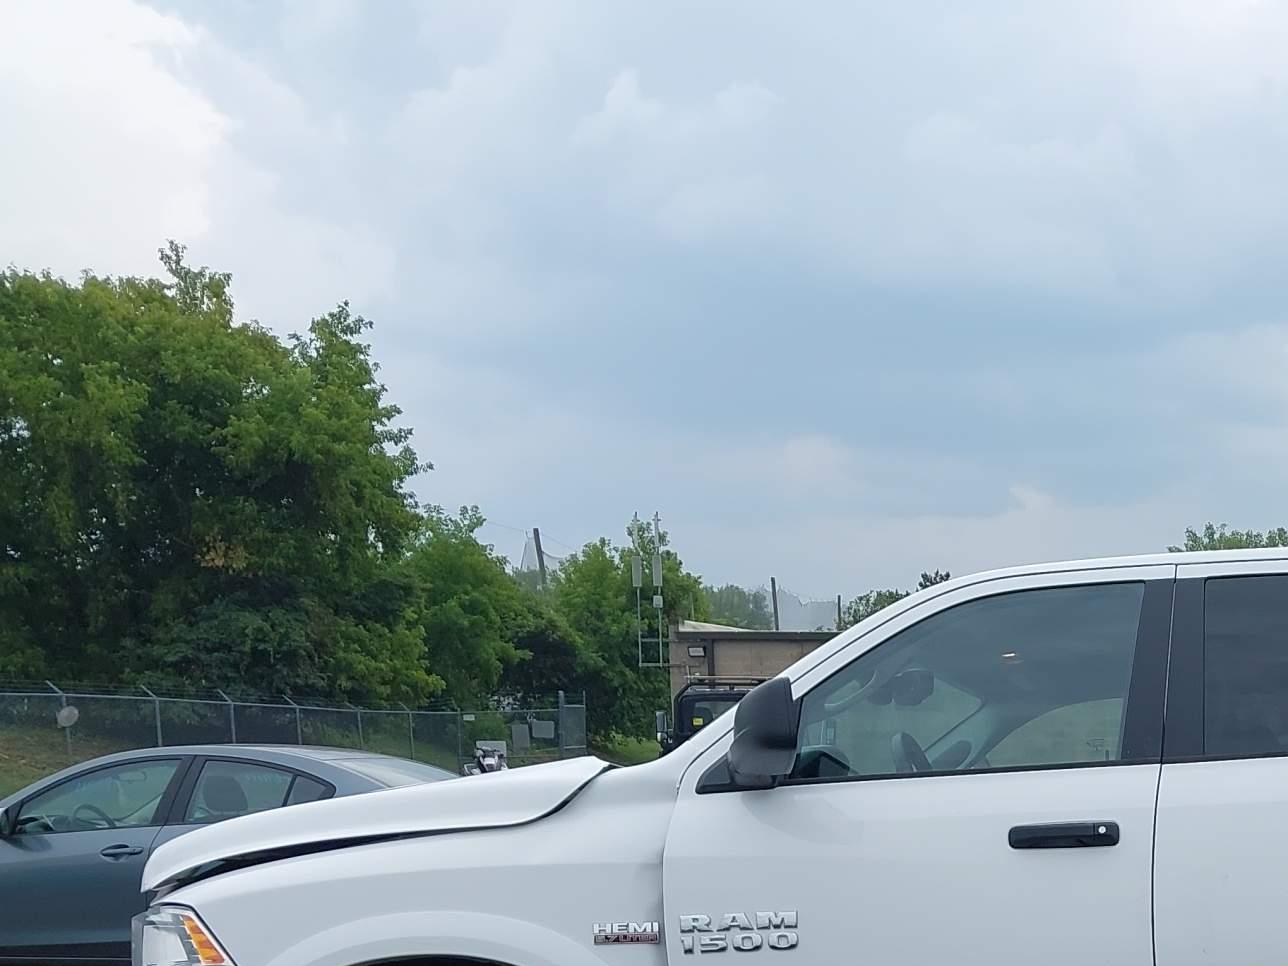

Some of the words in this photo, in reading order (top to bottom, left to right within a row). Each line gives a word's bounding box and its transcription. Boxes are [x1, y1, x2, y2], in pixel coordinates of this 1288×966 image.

[593, 921, 659, 934] HEMI
[679, 911, 799, 932] RAM
[680, 932, 800, 954] 1500
